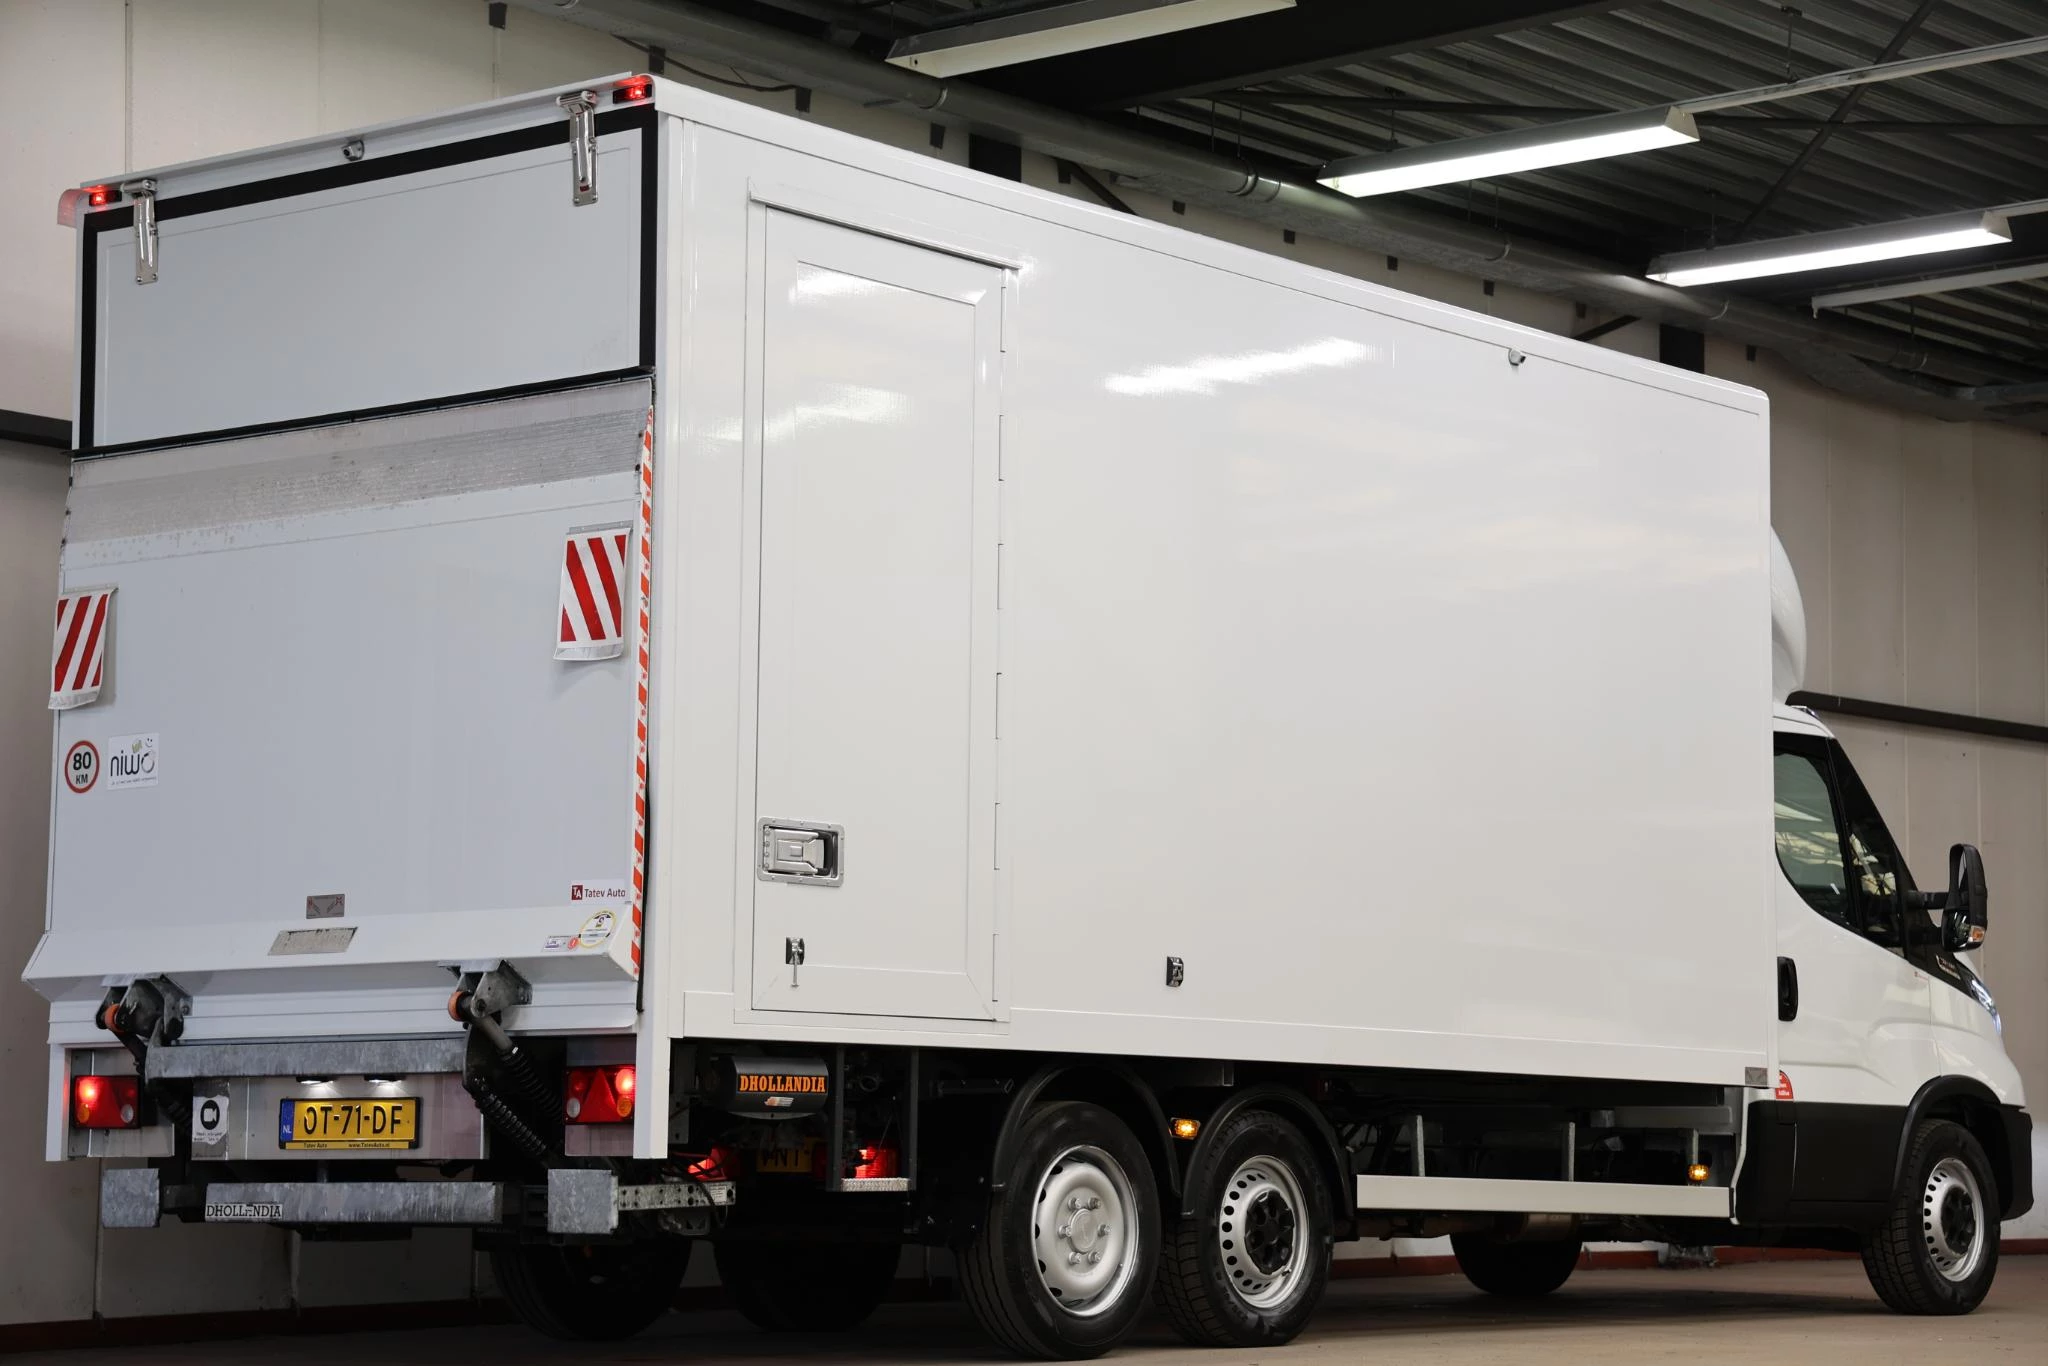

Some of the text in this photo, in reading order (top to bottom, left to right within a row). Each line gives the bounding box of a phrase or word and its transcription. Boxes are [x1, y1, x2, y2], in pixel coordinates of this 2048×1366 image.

[73, 751, 92, 771] 80
[110, 750, 155, 777] niwo
[75, 773, 89, 785] KM
[584, 888, 626, 898] Tatev Auto
[739, 1075, 826, 1093] DHOLLANDIA
[303, 1105, 403, 1135] OT-71-DF
[282, 1125, 292, 1134] NL
